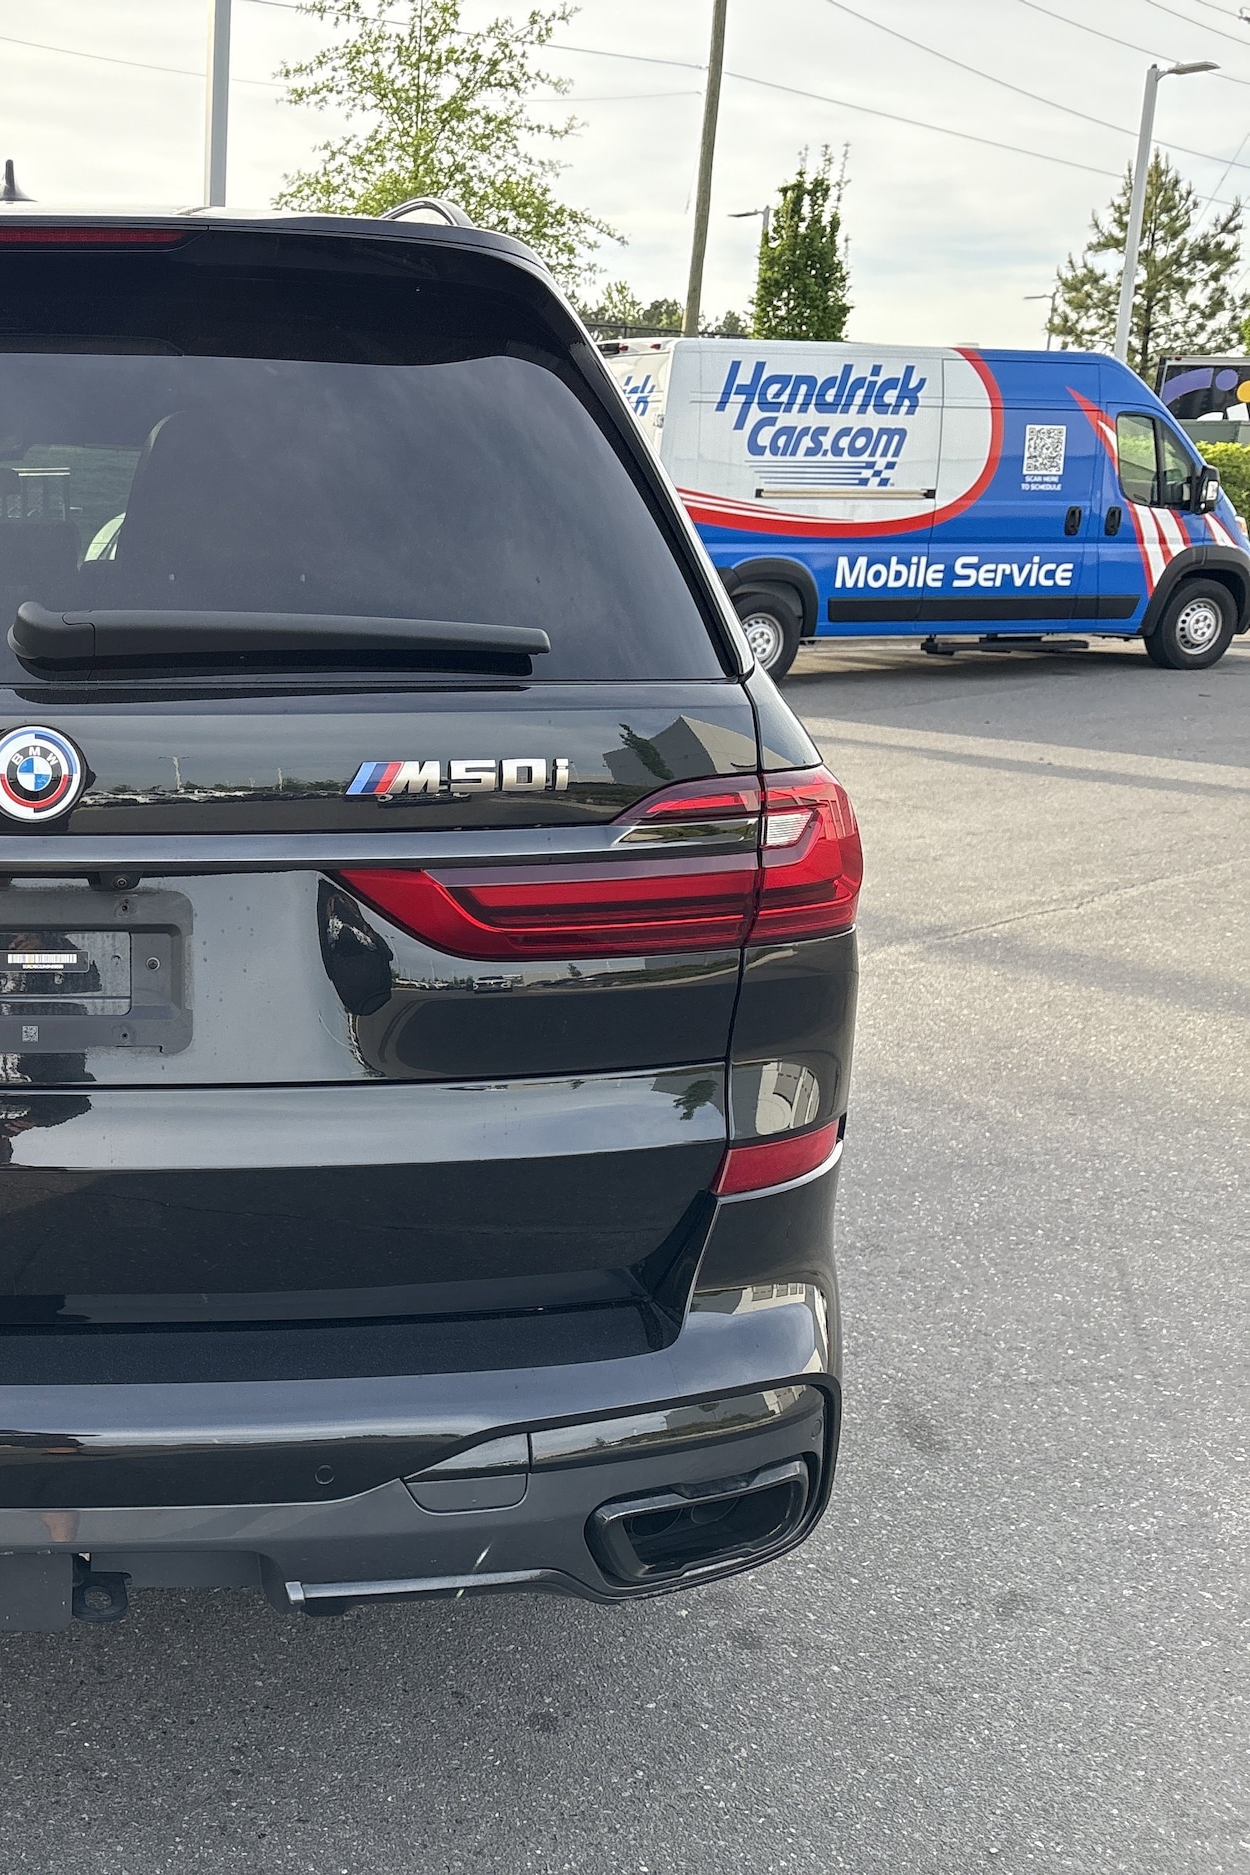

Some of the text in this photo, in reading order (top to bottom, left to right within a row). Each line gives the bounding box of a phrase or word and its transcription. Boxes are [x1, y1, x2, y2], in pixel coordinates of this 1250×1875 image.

[715, 360, 927, 430] Hendrick
[747, 416, 908, 458] Cars.com
[1021, 483, 1030, 491] TO
[834, 556, 1074, 588] Mobile Service
[11, 746, 59, 766] BMW
[384, 757, 569, 795] M50i
